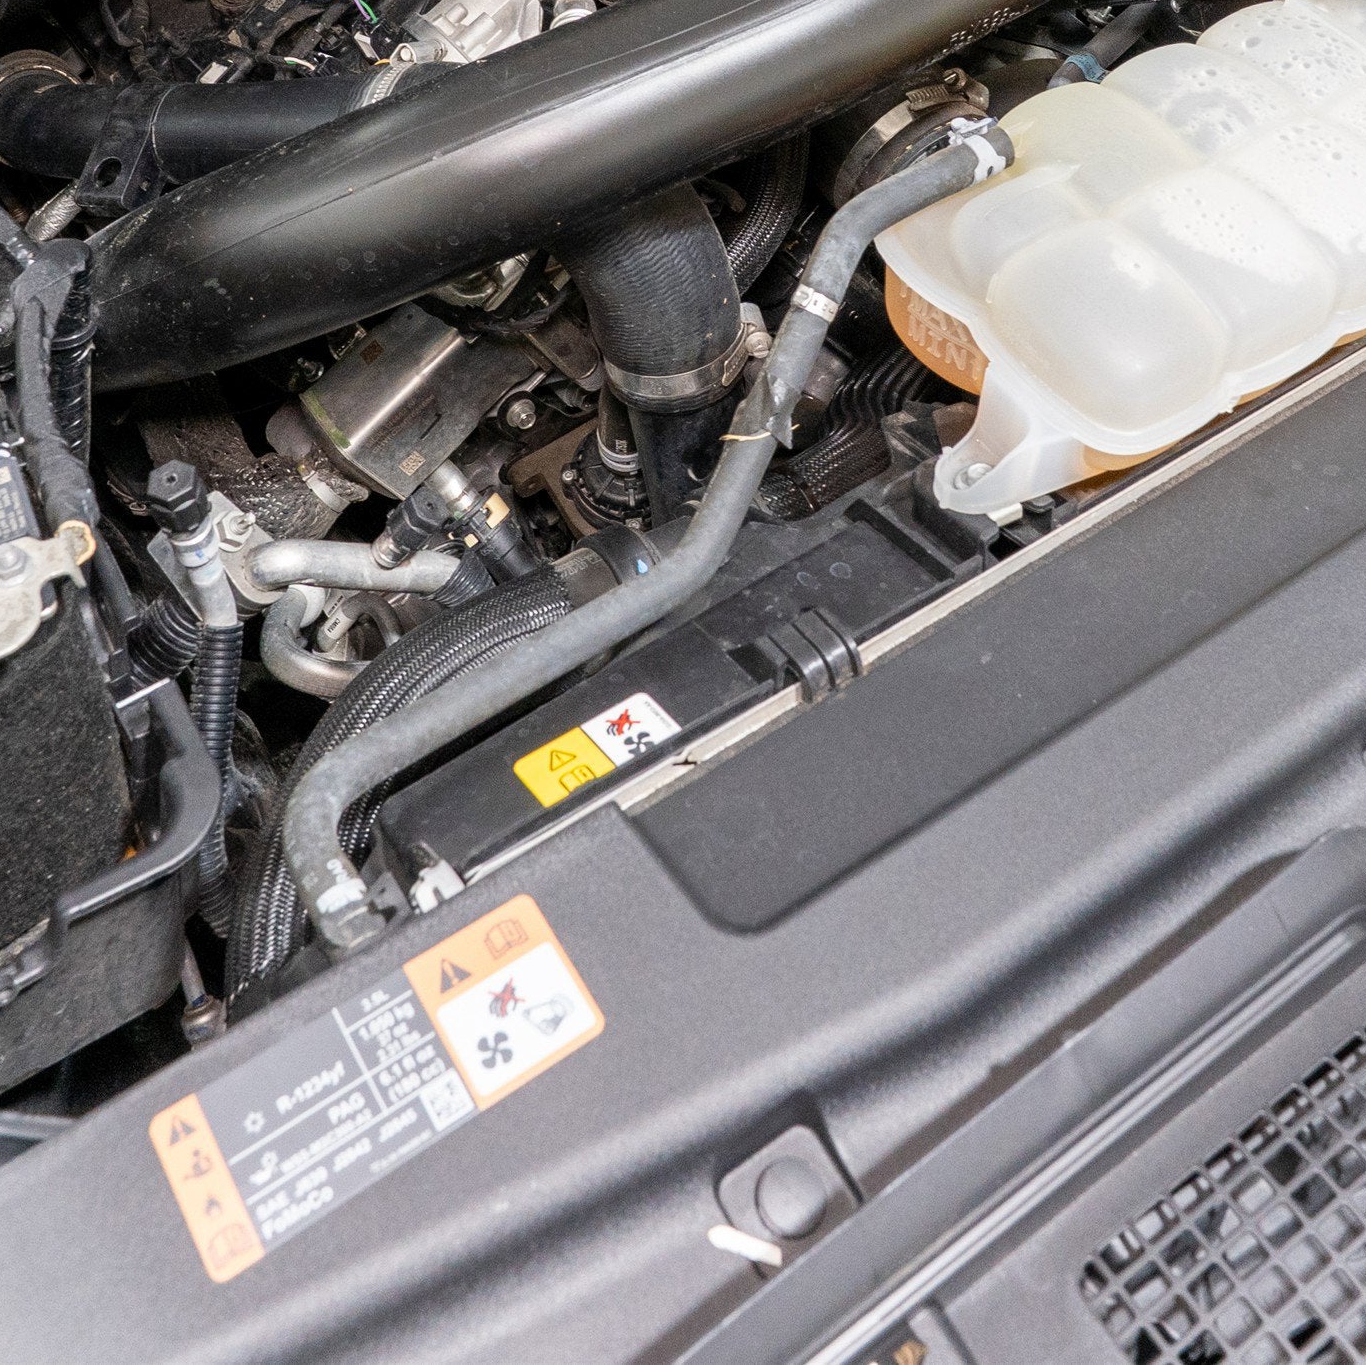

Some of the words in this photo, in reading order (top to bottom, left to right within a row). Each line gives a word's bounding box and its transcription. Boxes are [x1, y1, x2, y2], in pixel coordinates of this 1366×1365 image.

[908, 314, 967, 371] MIN
[274, 1060, 346, 1114] R-1234yf
[327, 1091, 366, 1125] PAG
[262, 1186, 335, 1239] FoMoCo
